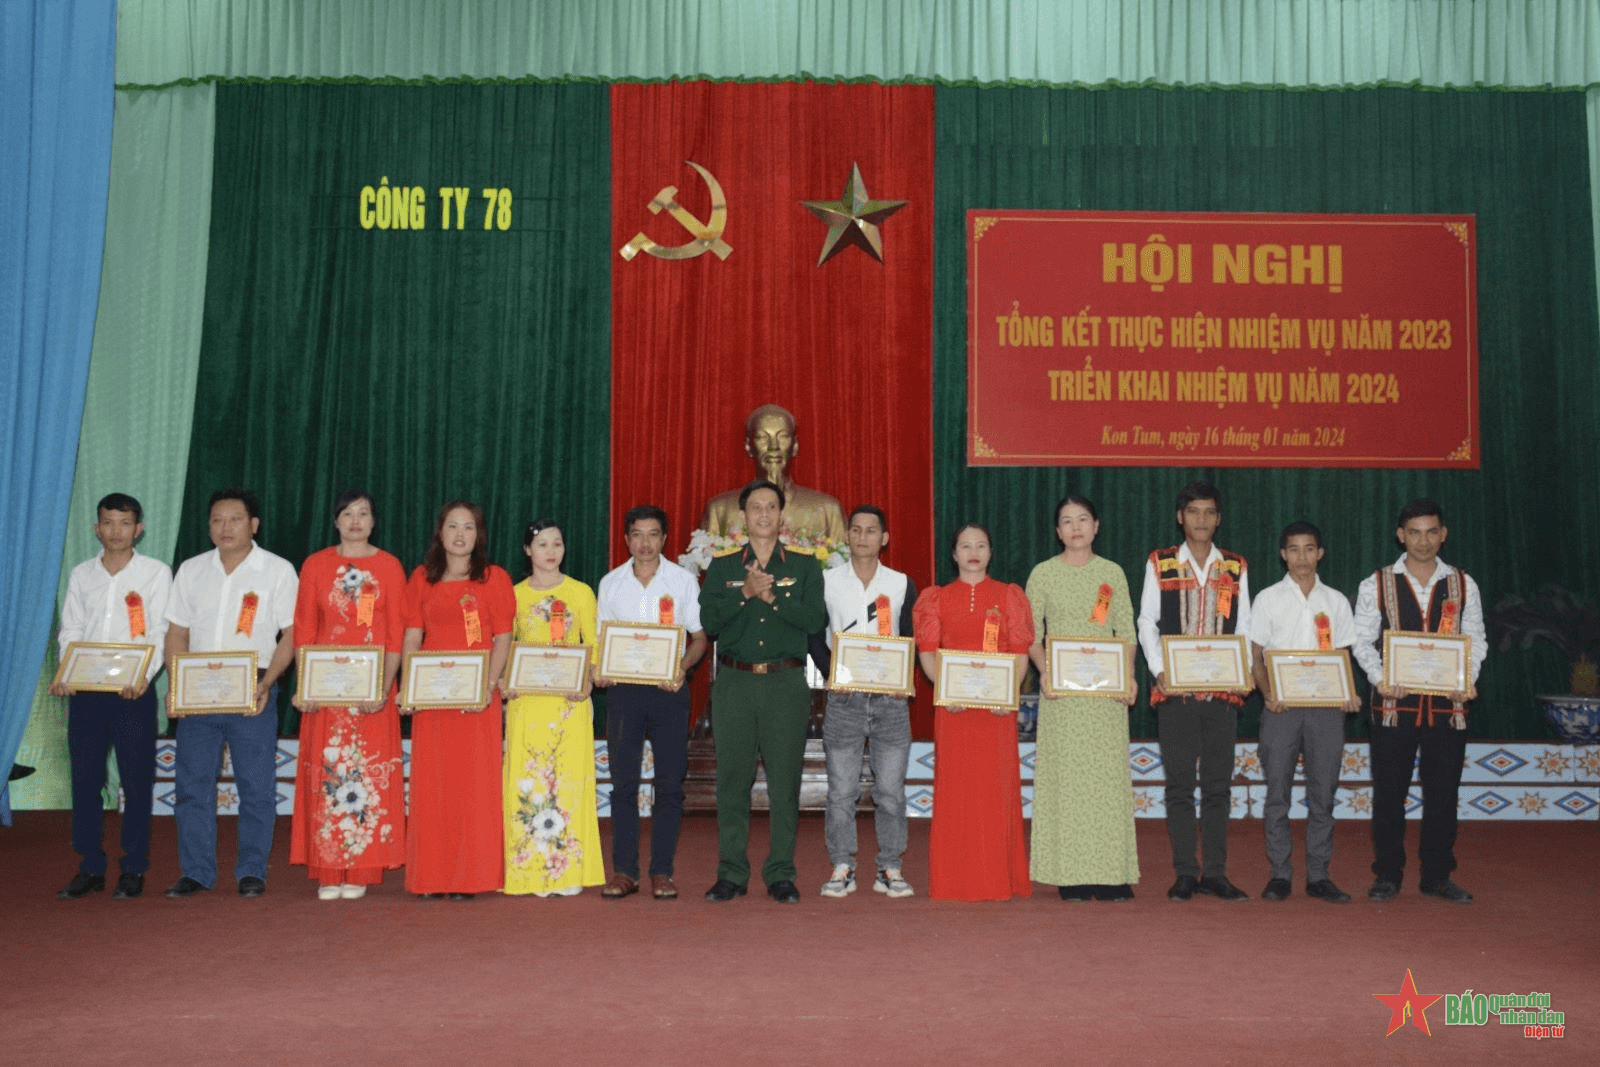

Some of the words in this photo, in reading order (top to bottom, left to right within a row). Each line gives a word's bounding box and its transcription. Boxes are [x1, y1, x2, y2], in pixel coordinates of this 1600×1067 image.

[359, 175, 426, 231] CÔNG
[439, 186, 470, 230] TY
[482, 187, 513, 231] 78
[1102, 233, 1193, 292] HỘI
[1212, 243, 1343, 293] NGHỊ
[995, 300, 1054, 347] TỔNG
[1061, 304, 1101, 347] KẾT
[1107, 315, 1164, 353] THỰC
[1170, 311, 1223, 353] HIỆN
[1228, 312, 1301, 355] NHIỆM
[1307, 318, 1335, 356] VỤ
[1342, 313, 1393, 350] NĂM
[1399, 318, 1452, 350] 2023
[1048, 355, 1112, 401] TRIỂN
[1118, 370, 1170, 401] KHAI
[1176, 365, 1248, 409] NHIỆM
[1254, 372, 1283, 409] VỤ
[1289, 366, 1340, 402] NĂM
[1347, 373, 1399, 404] 2024
[1101, 425, 1128, 445] Kon
[1132, 425, 1165, 447] Tum,
[1168, 425, 1200, 451] ngày
[1204, 426, 1219, 446] 16
[1222, 425, 1260, 451] tháng
[1263, 426, 1279, 446] 01
[1282, 428, 1310, 446] năm
[1314, 426, 1346, 447] 2024
